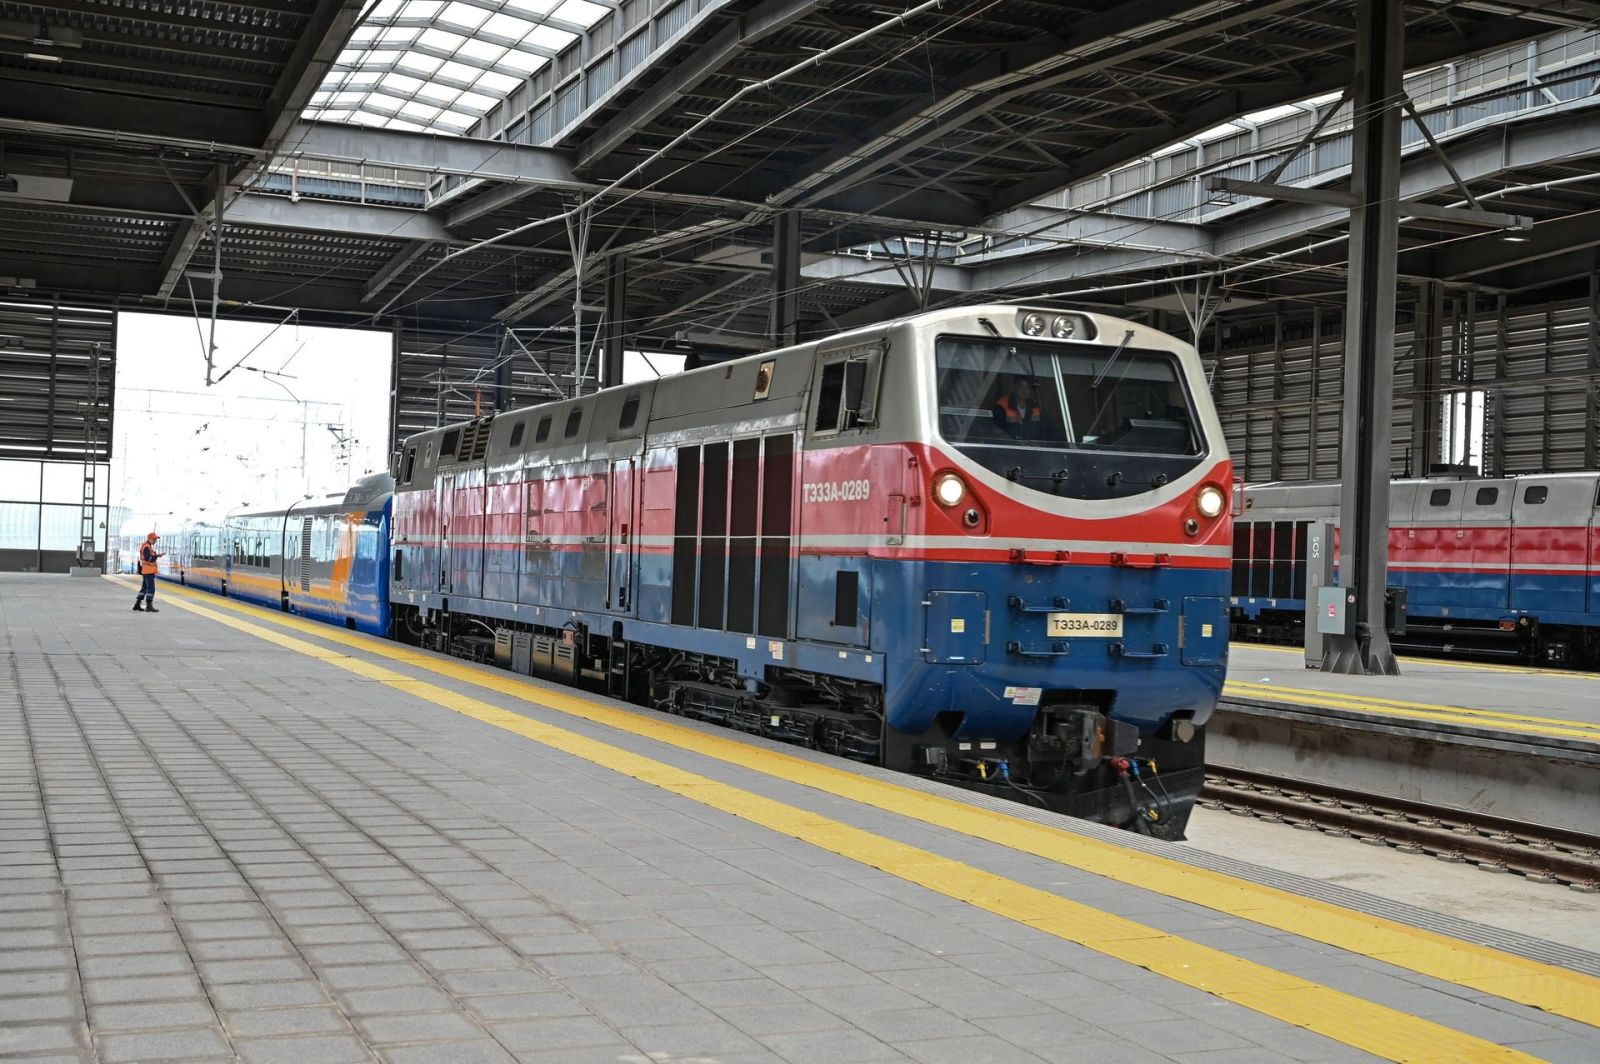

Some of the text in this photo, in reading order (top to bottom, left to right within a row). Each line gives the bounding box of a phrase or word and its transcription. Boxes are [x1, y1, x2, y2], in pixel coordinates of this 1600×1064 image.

[803, 480, 870, 503] ТЭ33А-0289
[1312, 536, 1320, 559] SOS
[1053, 619, 1118, 631] ТЭ33А-0289
